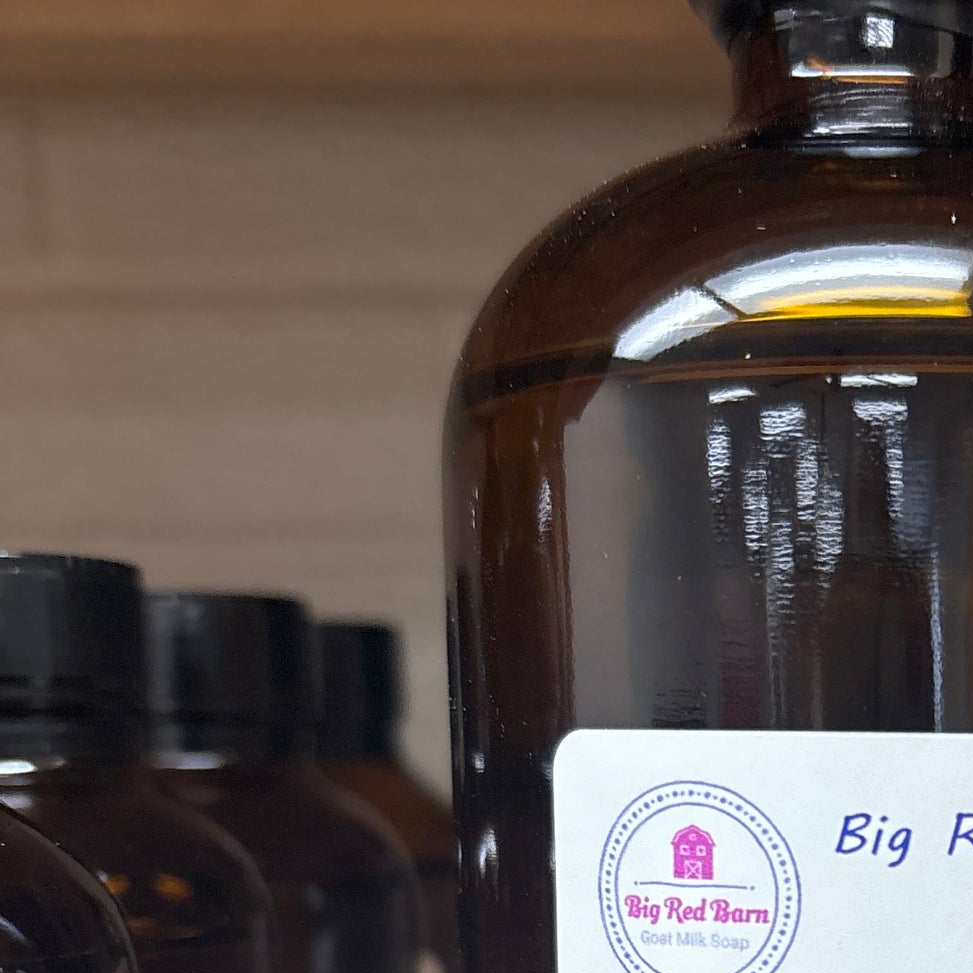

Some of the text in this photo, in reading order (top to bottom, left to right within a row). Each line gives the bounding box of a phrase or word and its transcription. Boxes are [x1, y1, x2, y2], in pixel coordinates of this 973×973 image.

[835, 812, 912, 868] Big
[624, 894, 770, 925] Big Red Barn
[640, 930, 750, 952] Goat Milk Soap
